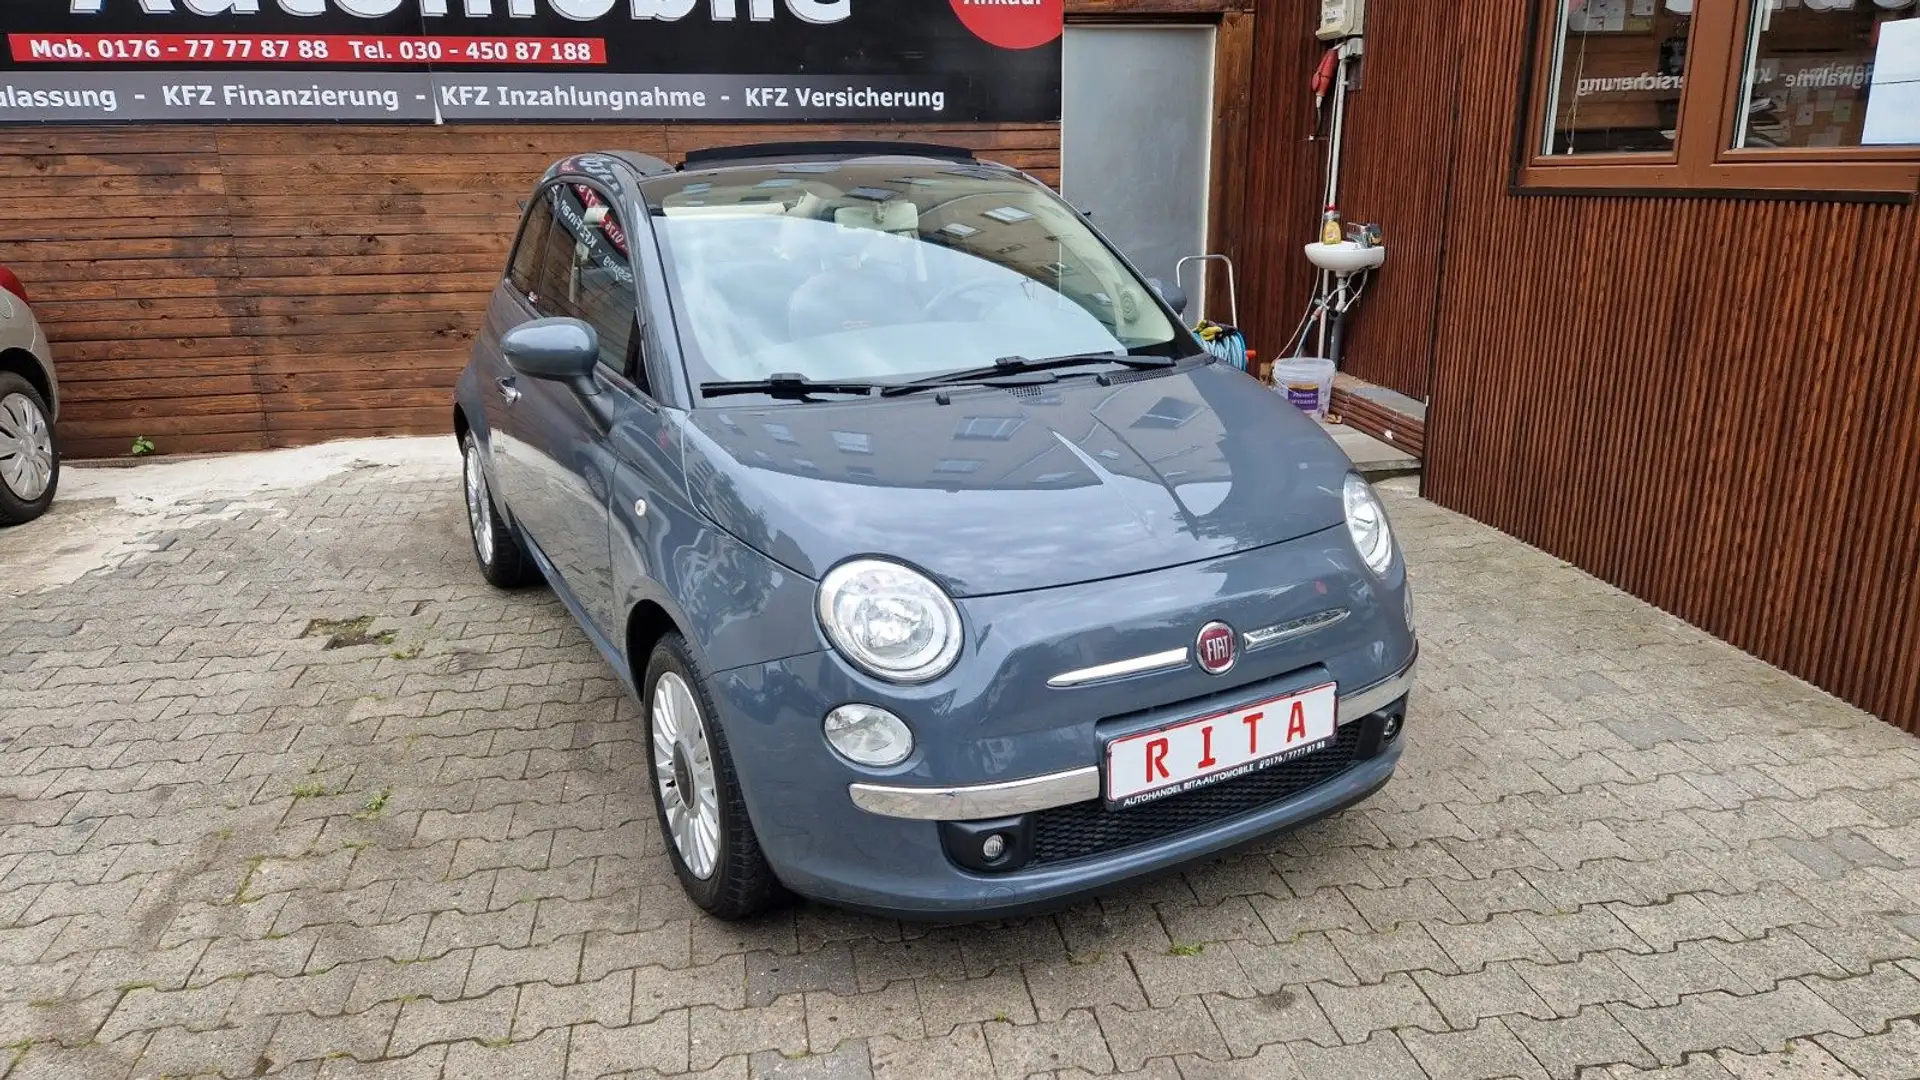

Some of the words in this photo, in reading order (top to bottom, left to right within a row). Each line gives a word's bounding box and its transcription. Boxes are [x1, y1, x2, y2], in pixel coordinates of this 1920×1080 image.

[30, 39, 91, 58] Mob.
[97, 39, 161, 58] 0176
[184, 39, 214, 58] 77
[222, 39, 252, 58] 77
[260, 39, 290, 58] 87
[297, 39, 329, 59] 88
[348, 40, 393, 59] Tel.
[399, 41, 442, 60] 030
[465, 41, 508, 60] 450
[514, 42, 542, 60] 87
[550, 42, 591, 61] 188
[162, 85, 216, 106] KFZ
[223, 85, 399, 111] Finanzierung
[441, 86, 490, 106] KFZ
[497, 85, 706, 111] Inzahlungnahme
[745, 87, 789, 107] KFZ
[795, 86, 944, 111] Versicherung
[1206, 635, 1229, 661] FIAT
[1123, 784, 1182, 807] AUTOHANDEL
[1183, 763, 1254, 791] RITA-AUTOMOBILE
